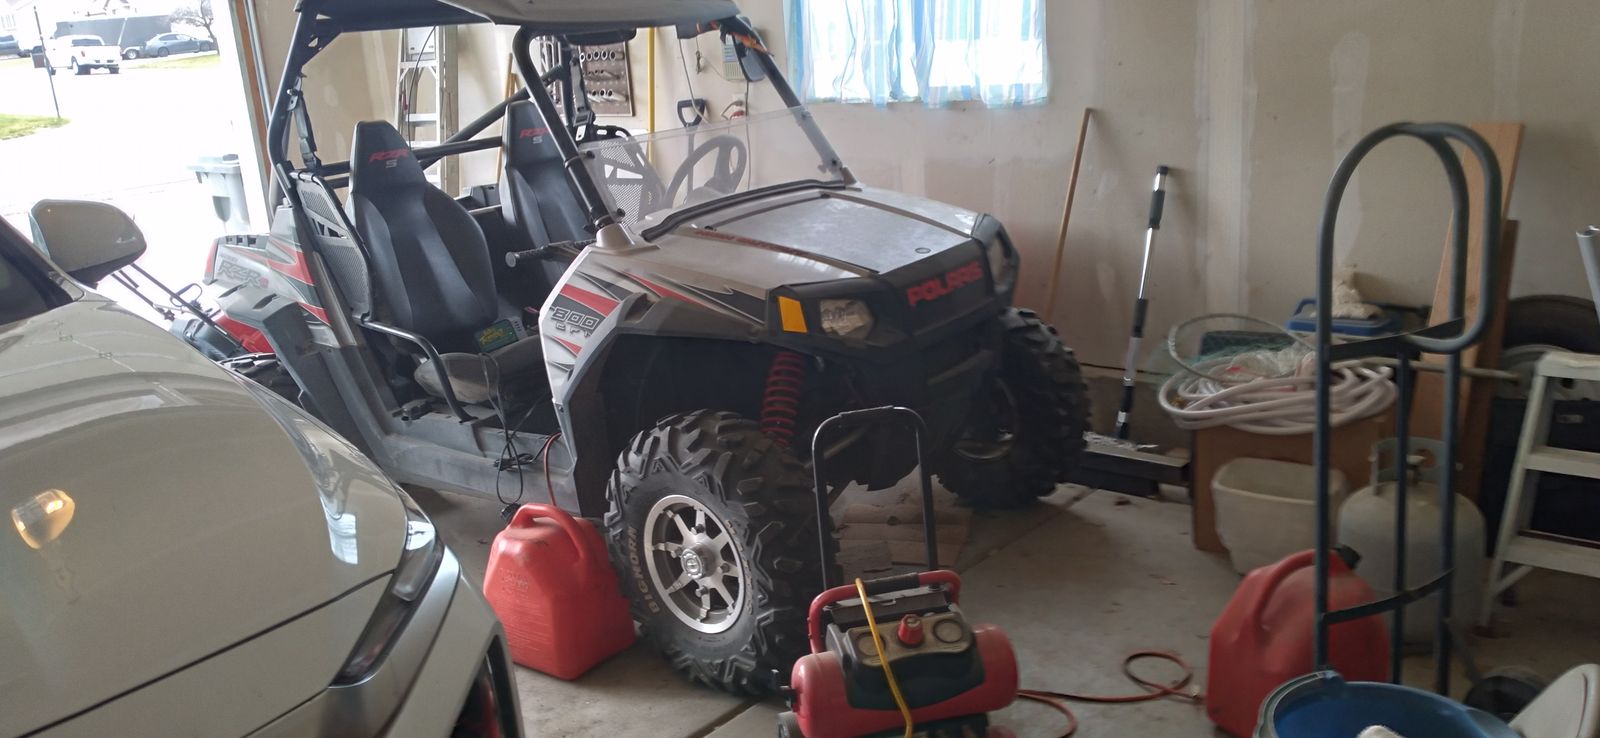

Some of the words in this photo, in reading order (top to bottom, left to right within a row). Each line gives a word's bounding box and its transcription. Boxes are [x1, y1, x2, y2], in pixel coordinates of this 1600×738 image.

[385, 160, 398, 169] S
[907, 260, 984, 308] POLARIS
[551, 306, 600, 330] 800
[626, 526, 660, 613] BIGHORN
